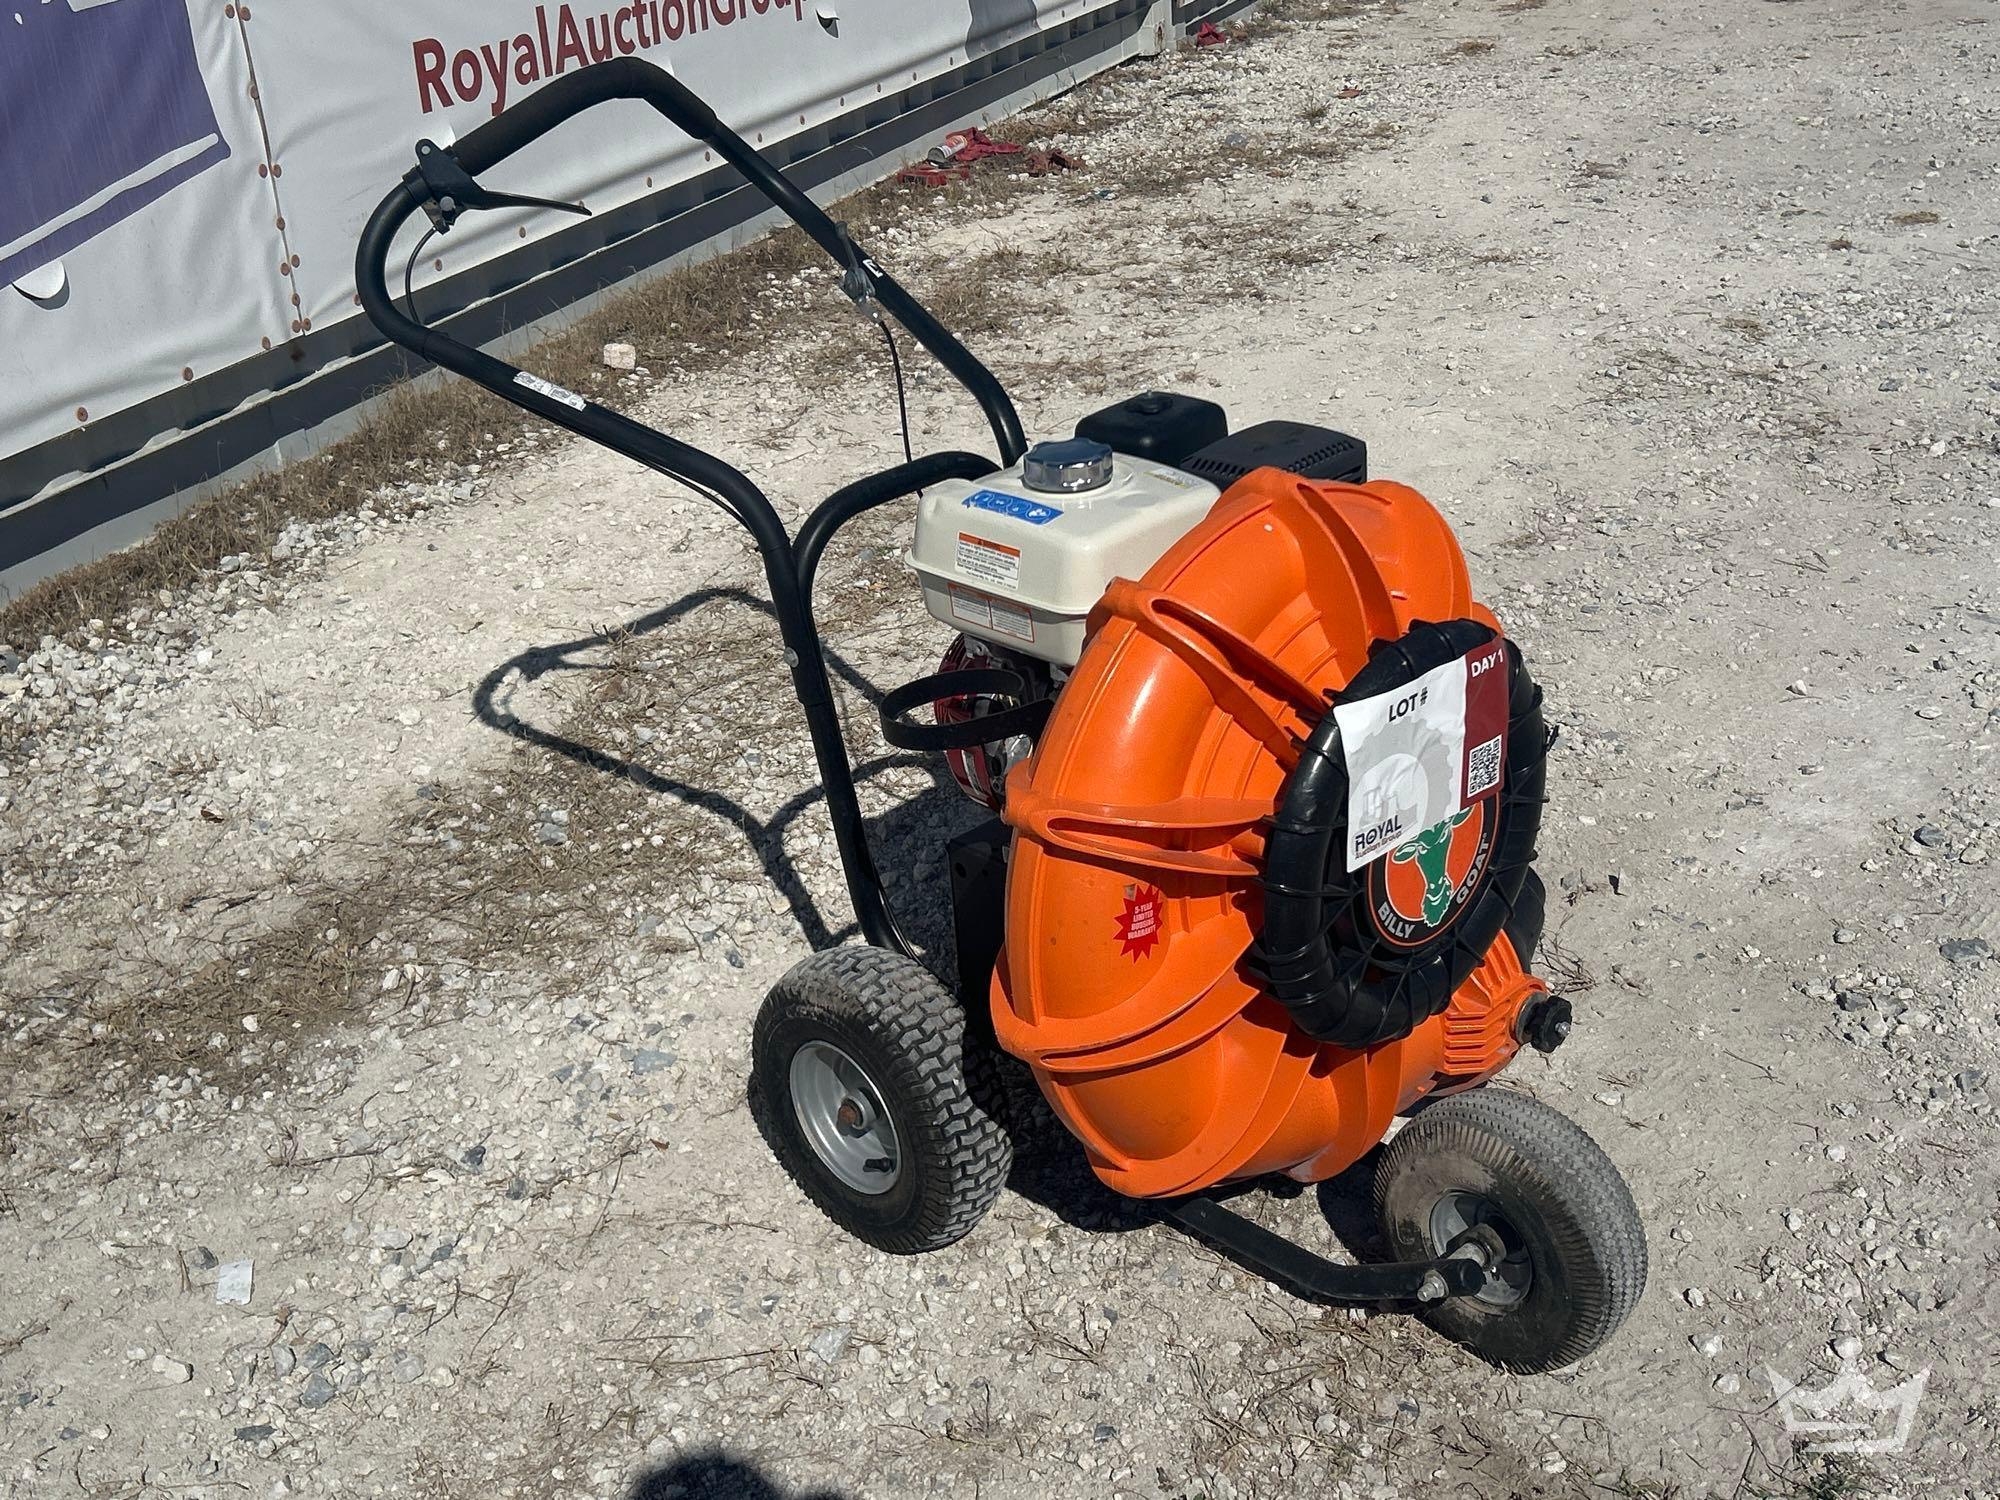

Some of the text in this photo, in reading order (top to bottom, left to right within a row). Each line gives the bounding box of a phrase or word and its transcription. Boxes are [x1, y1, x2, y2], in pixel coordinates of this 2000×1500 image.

[412, 0, 807, 117] RoyalAuction
[1471, 648, 1504, 678] DAY 1
[1389, 687, 1428, 722] LOT #
[1355, 814, 1402, 852] ROYAL
[1378, 901, 1416, 939] BILLY
